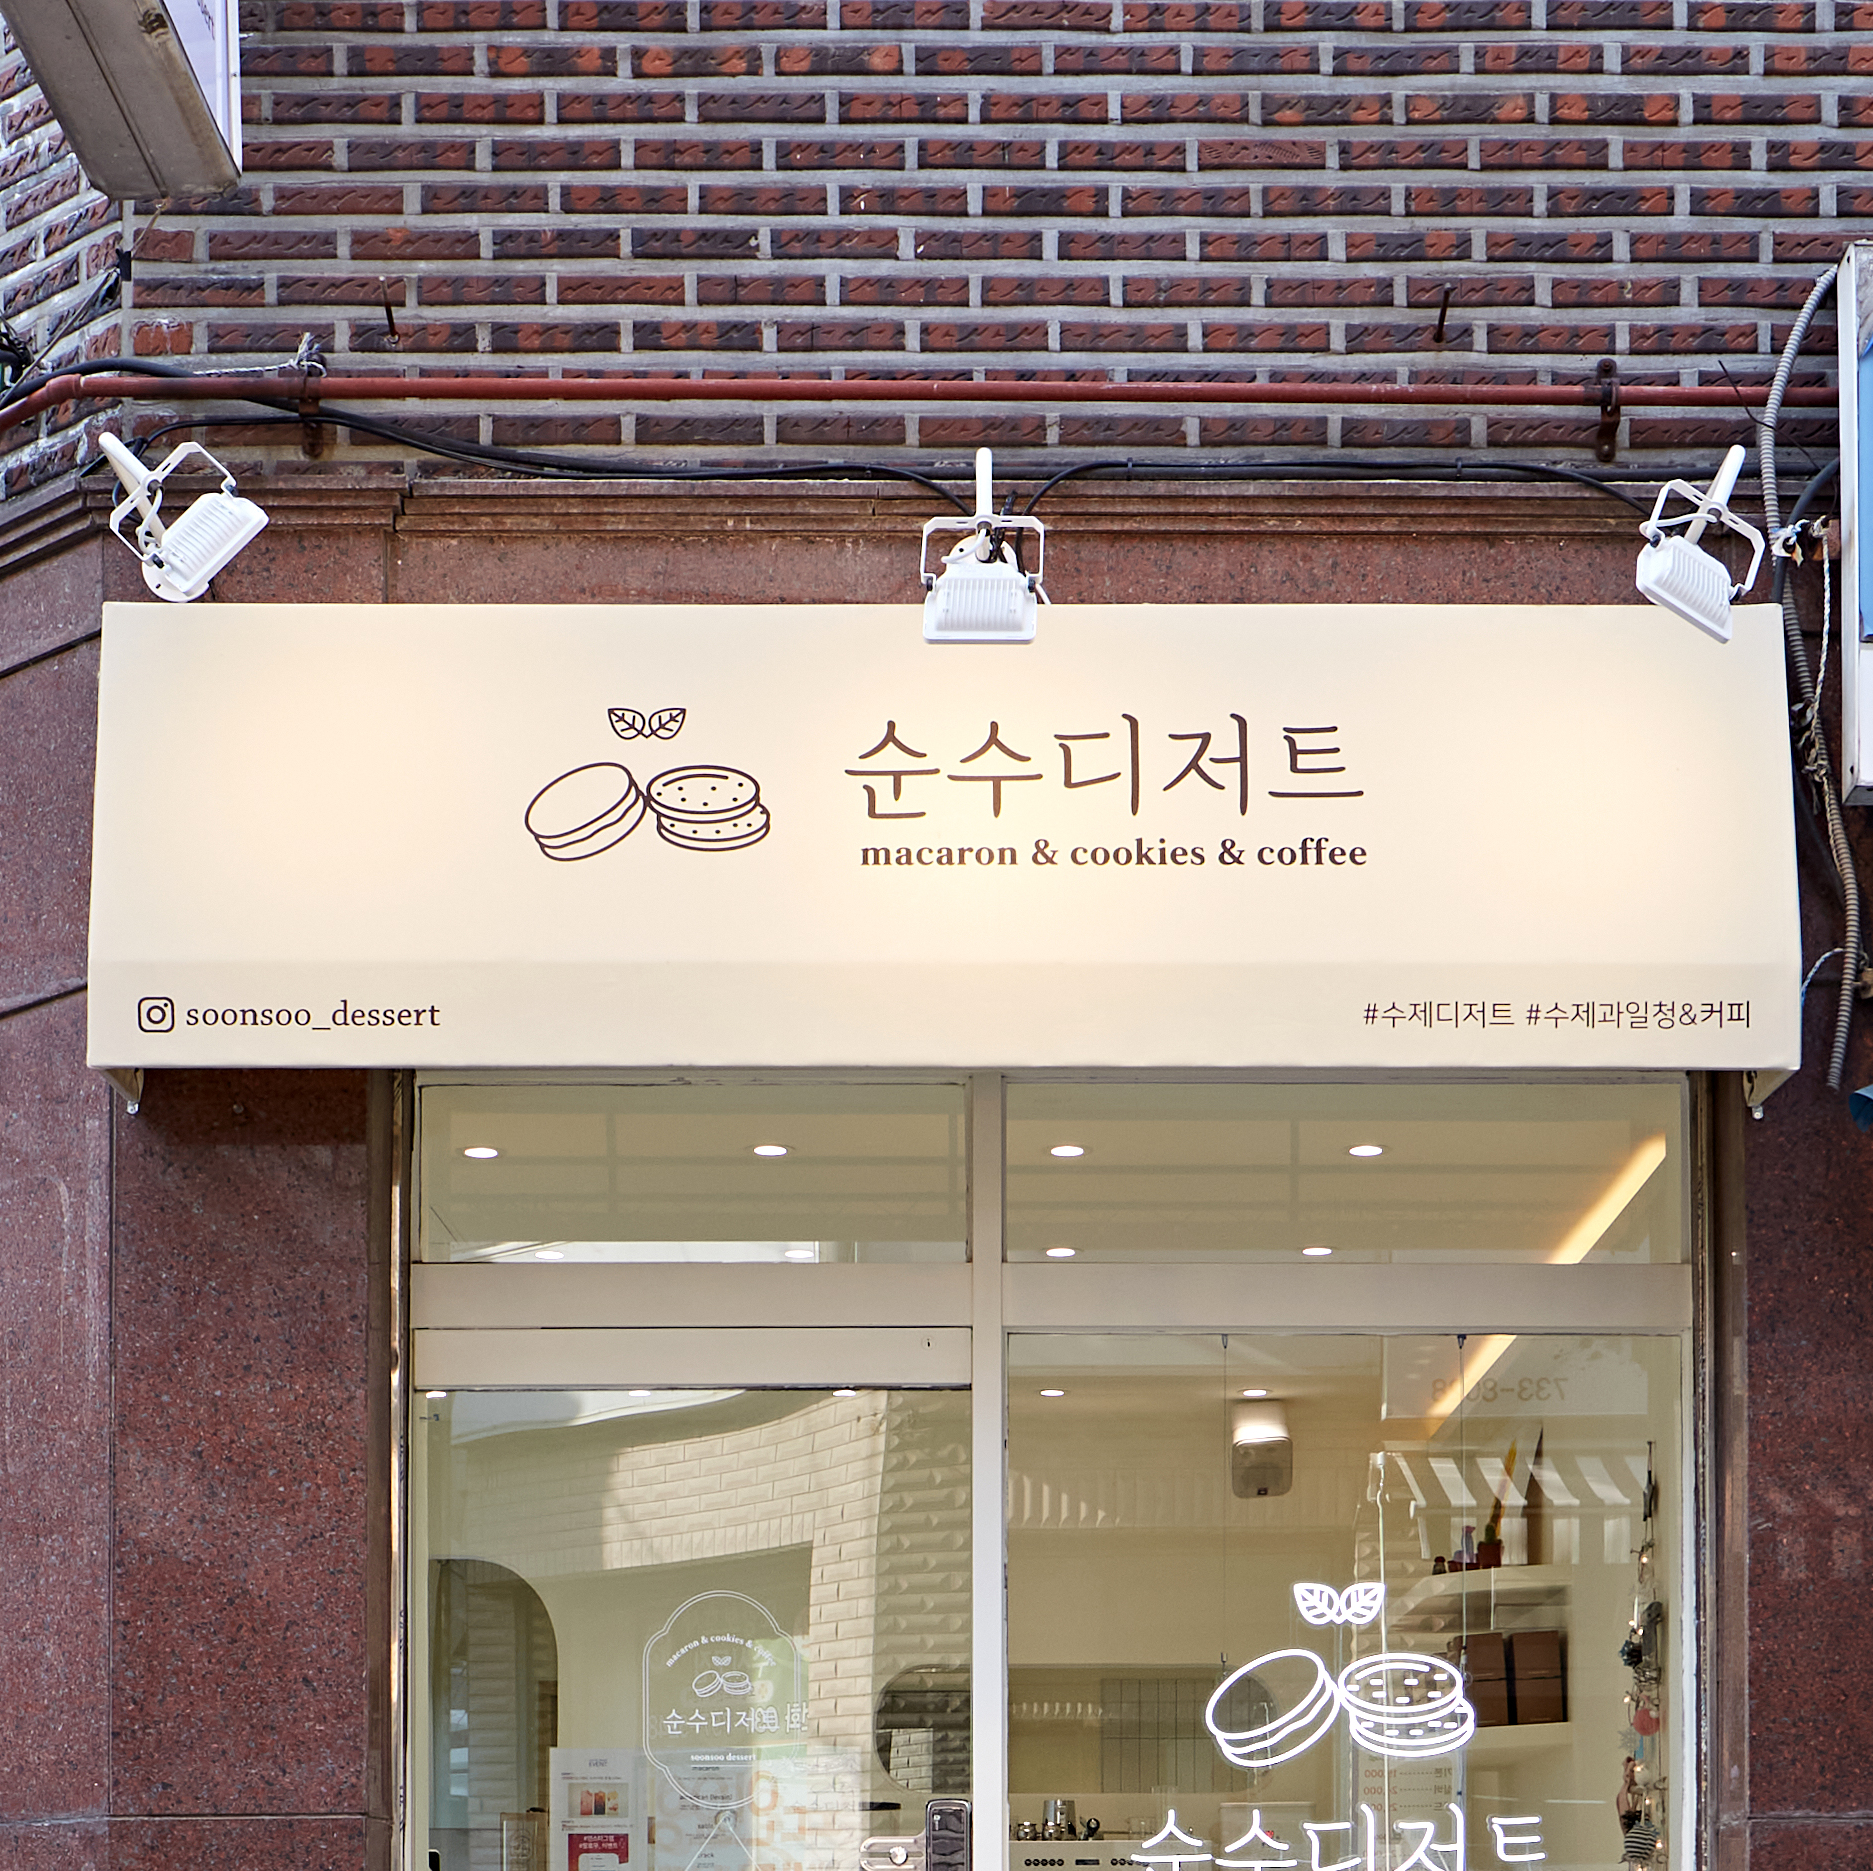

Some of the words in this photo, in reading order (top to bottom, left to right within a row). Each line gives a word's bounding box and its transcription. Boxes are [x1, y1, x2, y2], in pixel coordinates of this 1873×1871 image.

[844, 713, 1364, 819] 순수디저트
[859, 844, 1018, 867] macaron
[1030, 838, 1059, 867] &
[1069, 837, 1206, 867] cookies
[1217, 838, 1245, 867] &
[1256, 837, 1367, 867] coffee
[186, 999, 441, 1030] soonsoo_dessert
[1363, 1000, 1515, 1029] #수제디저트
[1526, 999, 1751, 1030] #수제과일청&커피
[666, 1639, 700, 1667] macaron
[710, 1633, 745, 1646] cookies
[690, 1752, 725, 1762] soonsoo
[726, 1752, 757, 1762] dessert
